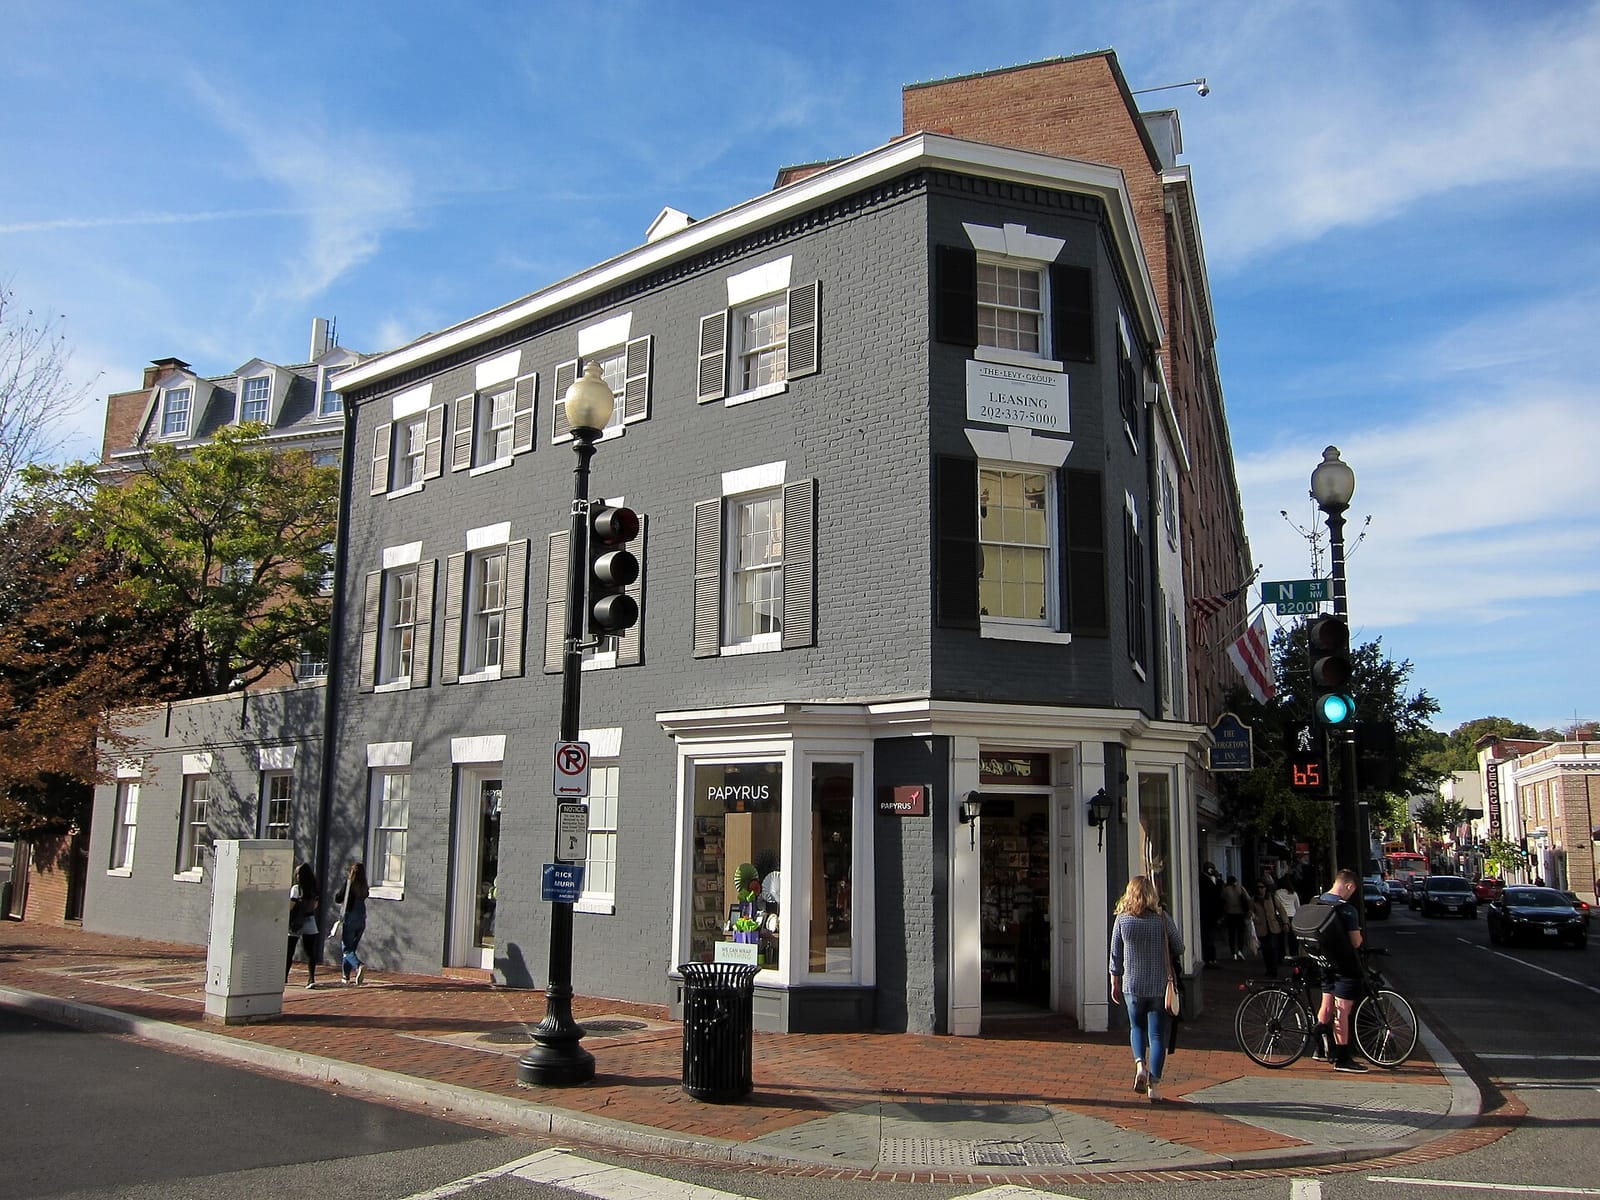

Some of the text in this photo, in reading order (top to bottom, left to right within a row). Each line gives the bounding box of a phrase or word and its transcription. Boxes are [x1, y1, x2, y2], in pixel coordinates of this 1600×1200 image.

[989, 392, 1048, 409] LEASING
[1279, 583, 1321, 600] N ST
[1310, 591, 1323, 599] NW
[1279, 602, 1315, 614] 3200
[1293, 764, 1320, 785] 65
[707, 785, 769, 800] PAPYRUS
[880, 802, 912, 810] PAPYRUS
[555, 871, 573, 879] RICK
